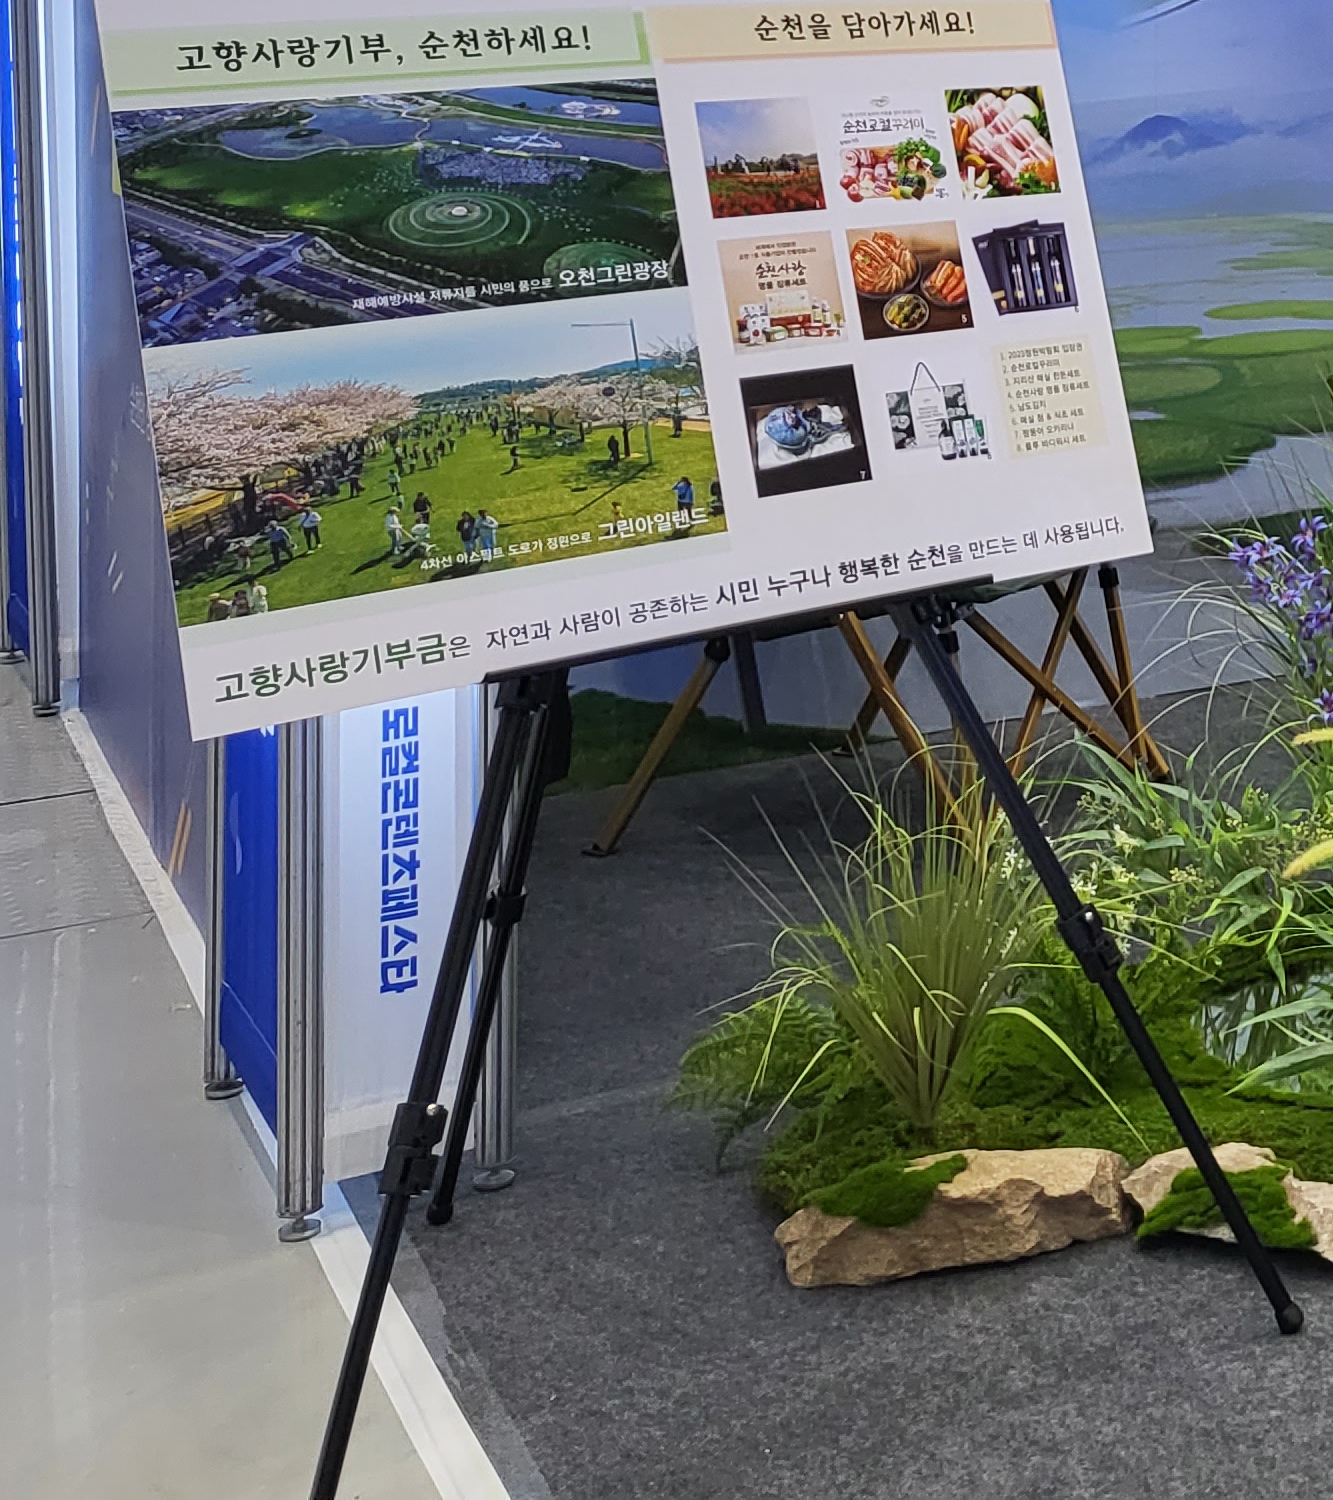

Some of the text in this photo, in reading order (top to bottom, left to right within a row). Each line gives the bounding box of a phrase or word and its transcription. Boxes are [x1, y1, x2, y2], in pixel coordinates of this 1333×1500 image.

[753, 10, 976, 42] 순천을 담아가세요!
[175, 23, 593, 73] 고향사랑기부, 순천하세요!
[842, 116, 925, 134] 순천로컬꾸러미
[479, 281, 516, 297] 시민의
[558, 259, 670, 289] 오천그린광장
[597, 507, 710, 542] 그린아일랜드
[213, 513, 1126, 704] 고향사랑기부금은 자연과 사람이 공존하는 시민 누구나 행복한 순천을 만드는 데 사용됩니다.
[379, 704, 422, 995] 로컬콘텐츠페스타
